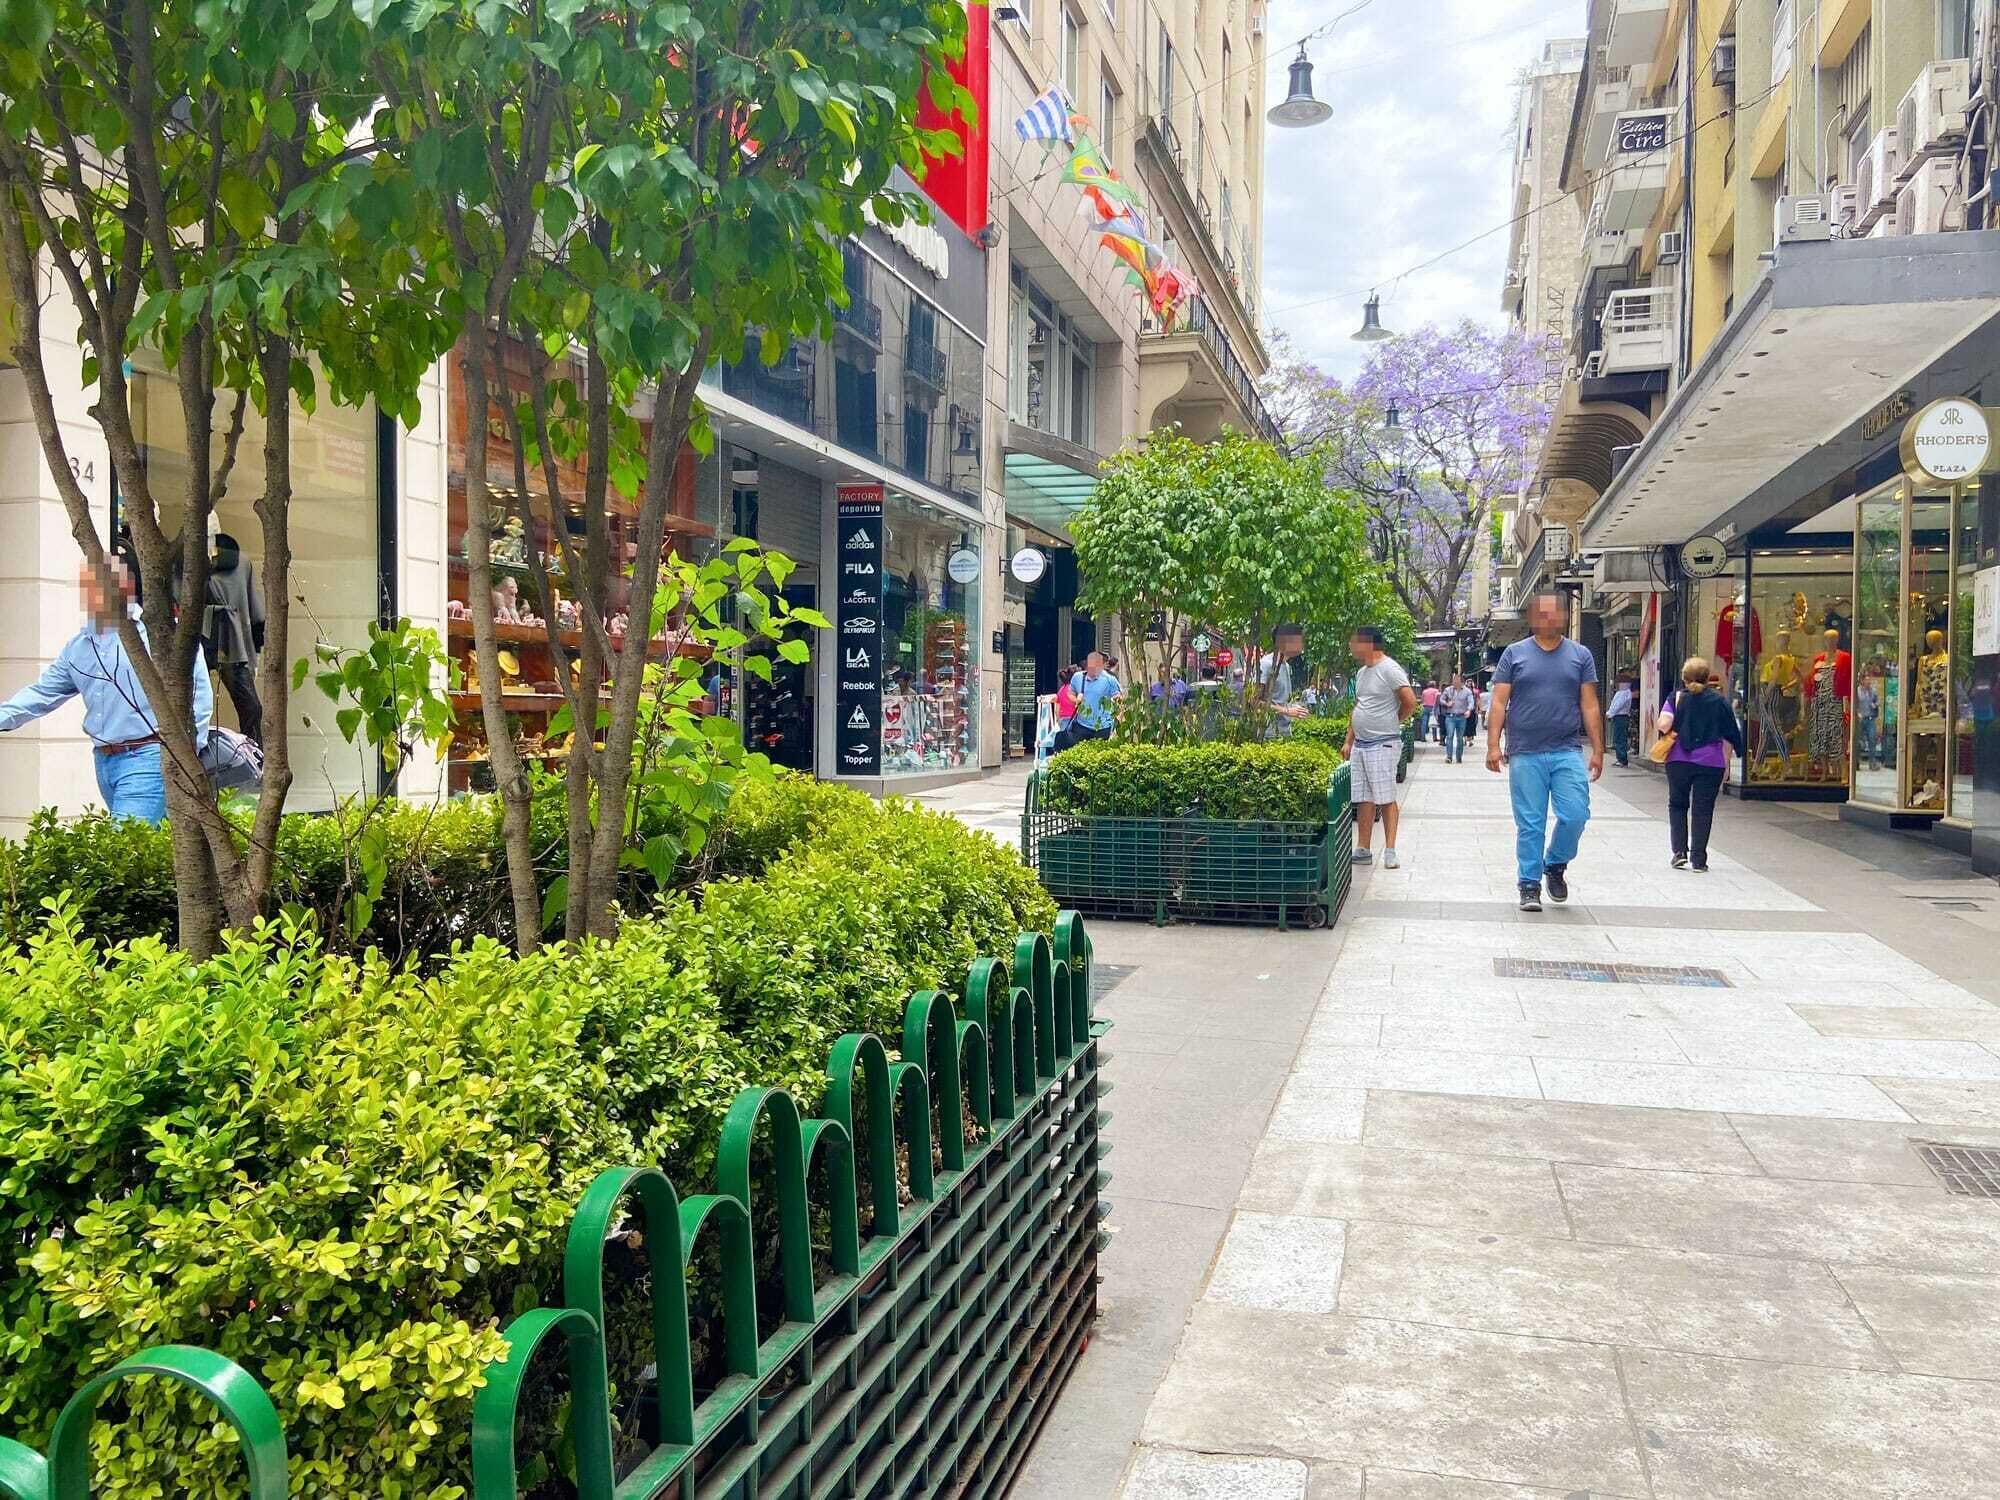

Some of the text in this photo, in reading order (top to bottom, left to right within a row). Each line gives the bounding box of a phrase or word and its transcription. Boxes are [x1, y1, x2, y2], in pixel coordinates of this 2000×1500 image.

[1915, 435, 1987, 446] RHODER'S
[1933, 465, 1967, 473] PLAZA
[840, 493, 880, 501] FACTORY
[845, 541, 875, 549] adidas
[845, 564, 874, 574] FILA
[847, 648, 870, 662] LA
[843, 682, 875, 690] Reebok
[844, 755, 872, 765] Topper
